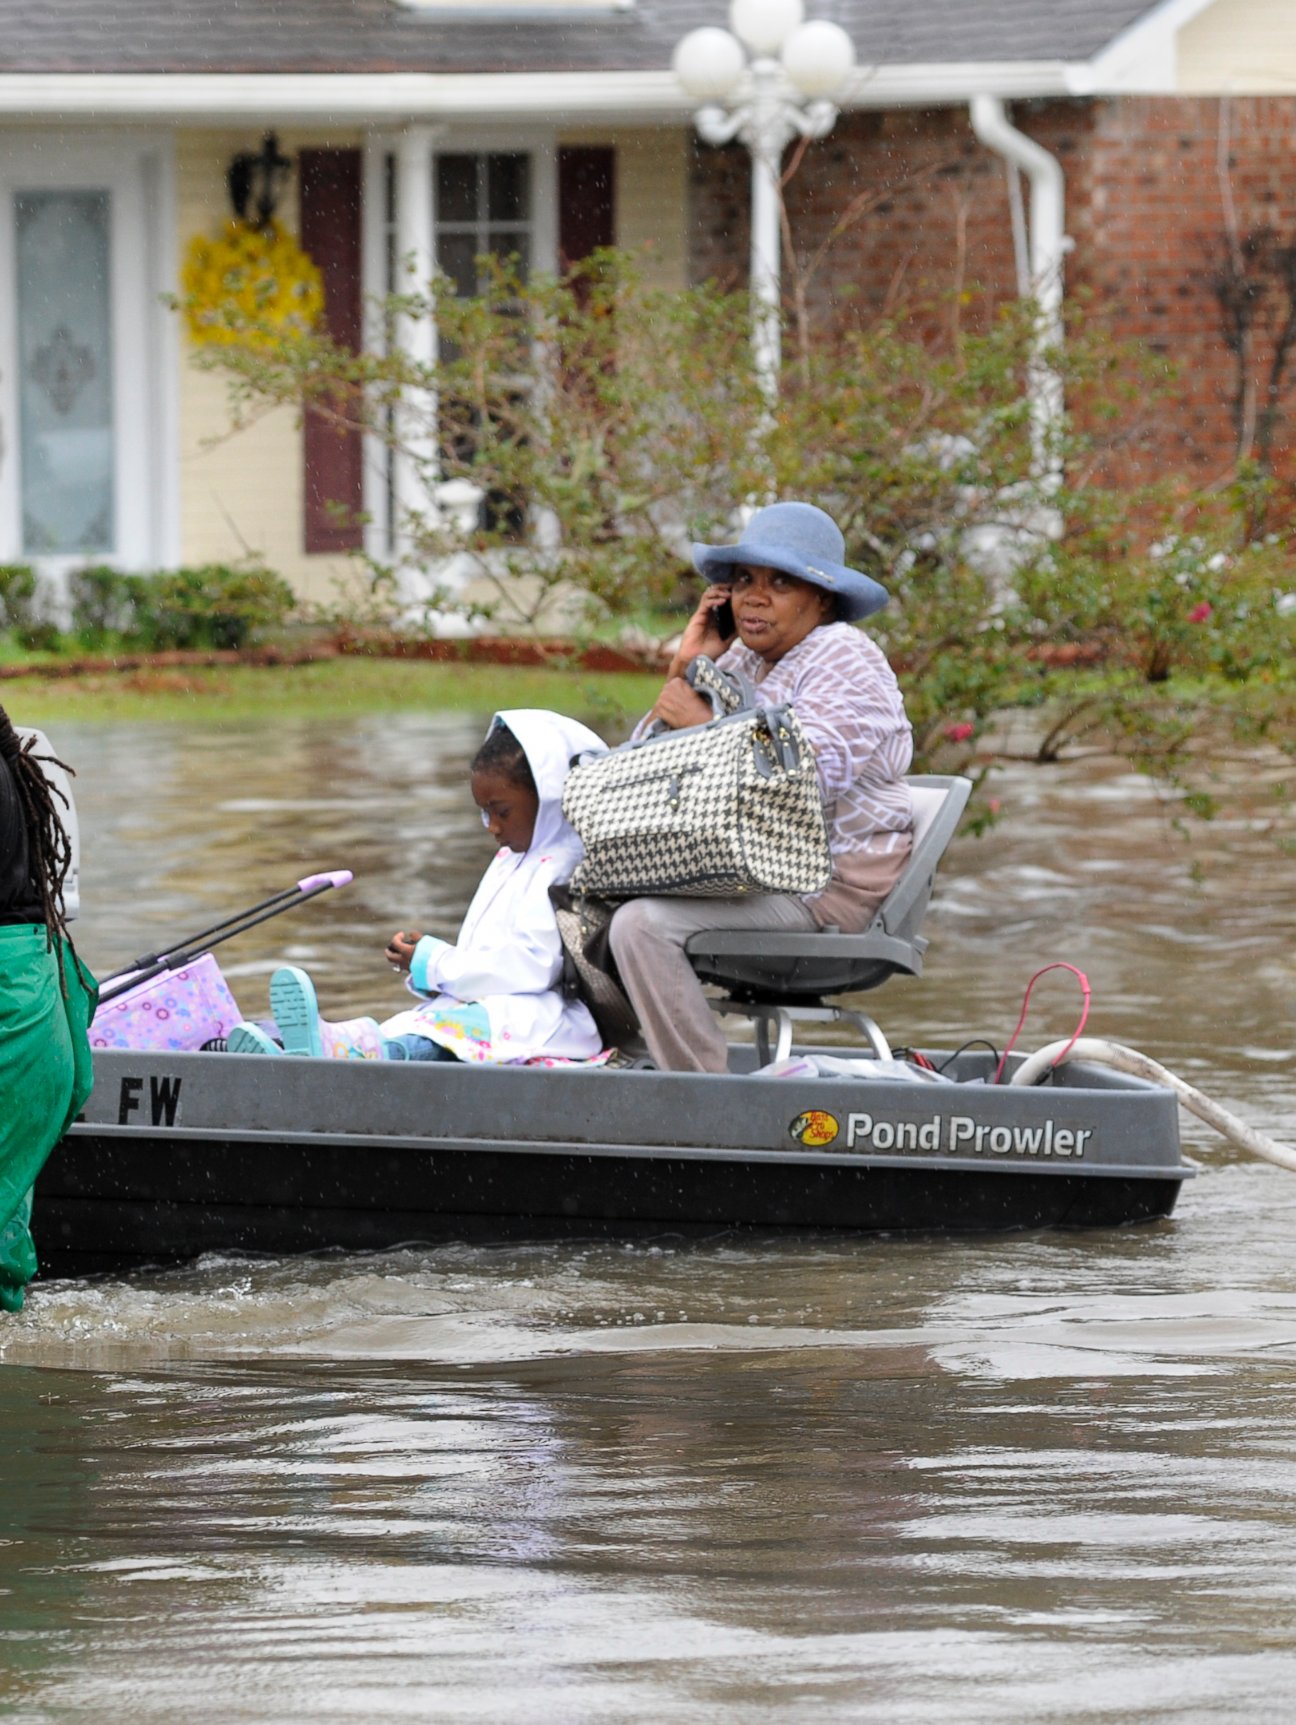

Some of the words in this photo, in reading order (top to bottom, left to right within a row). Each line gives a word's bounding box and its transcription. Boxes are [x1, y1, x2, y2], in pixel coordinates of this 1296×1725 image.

[118, 1076, 183, 1128] FW
[846, 1112, 942, 1151] Pond
[949, 1116, 1093, 1157] Prowler
